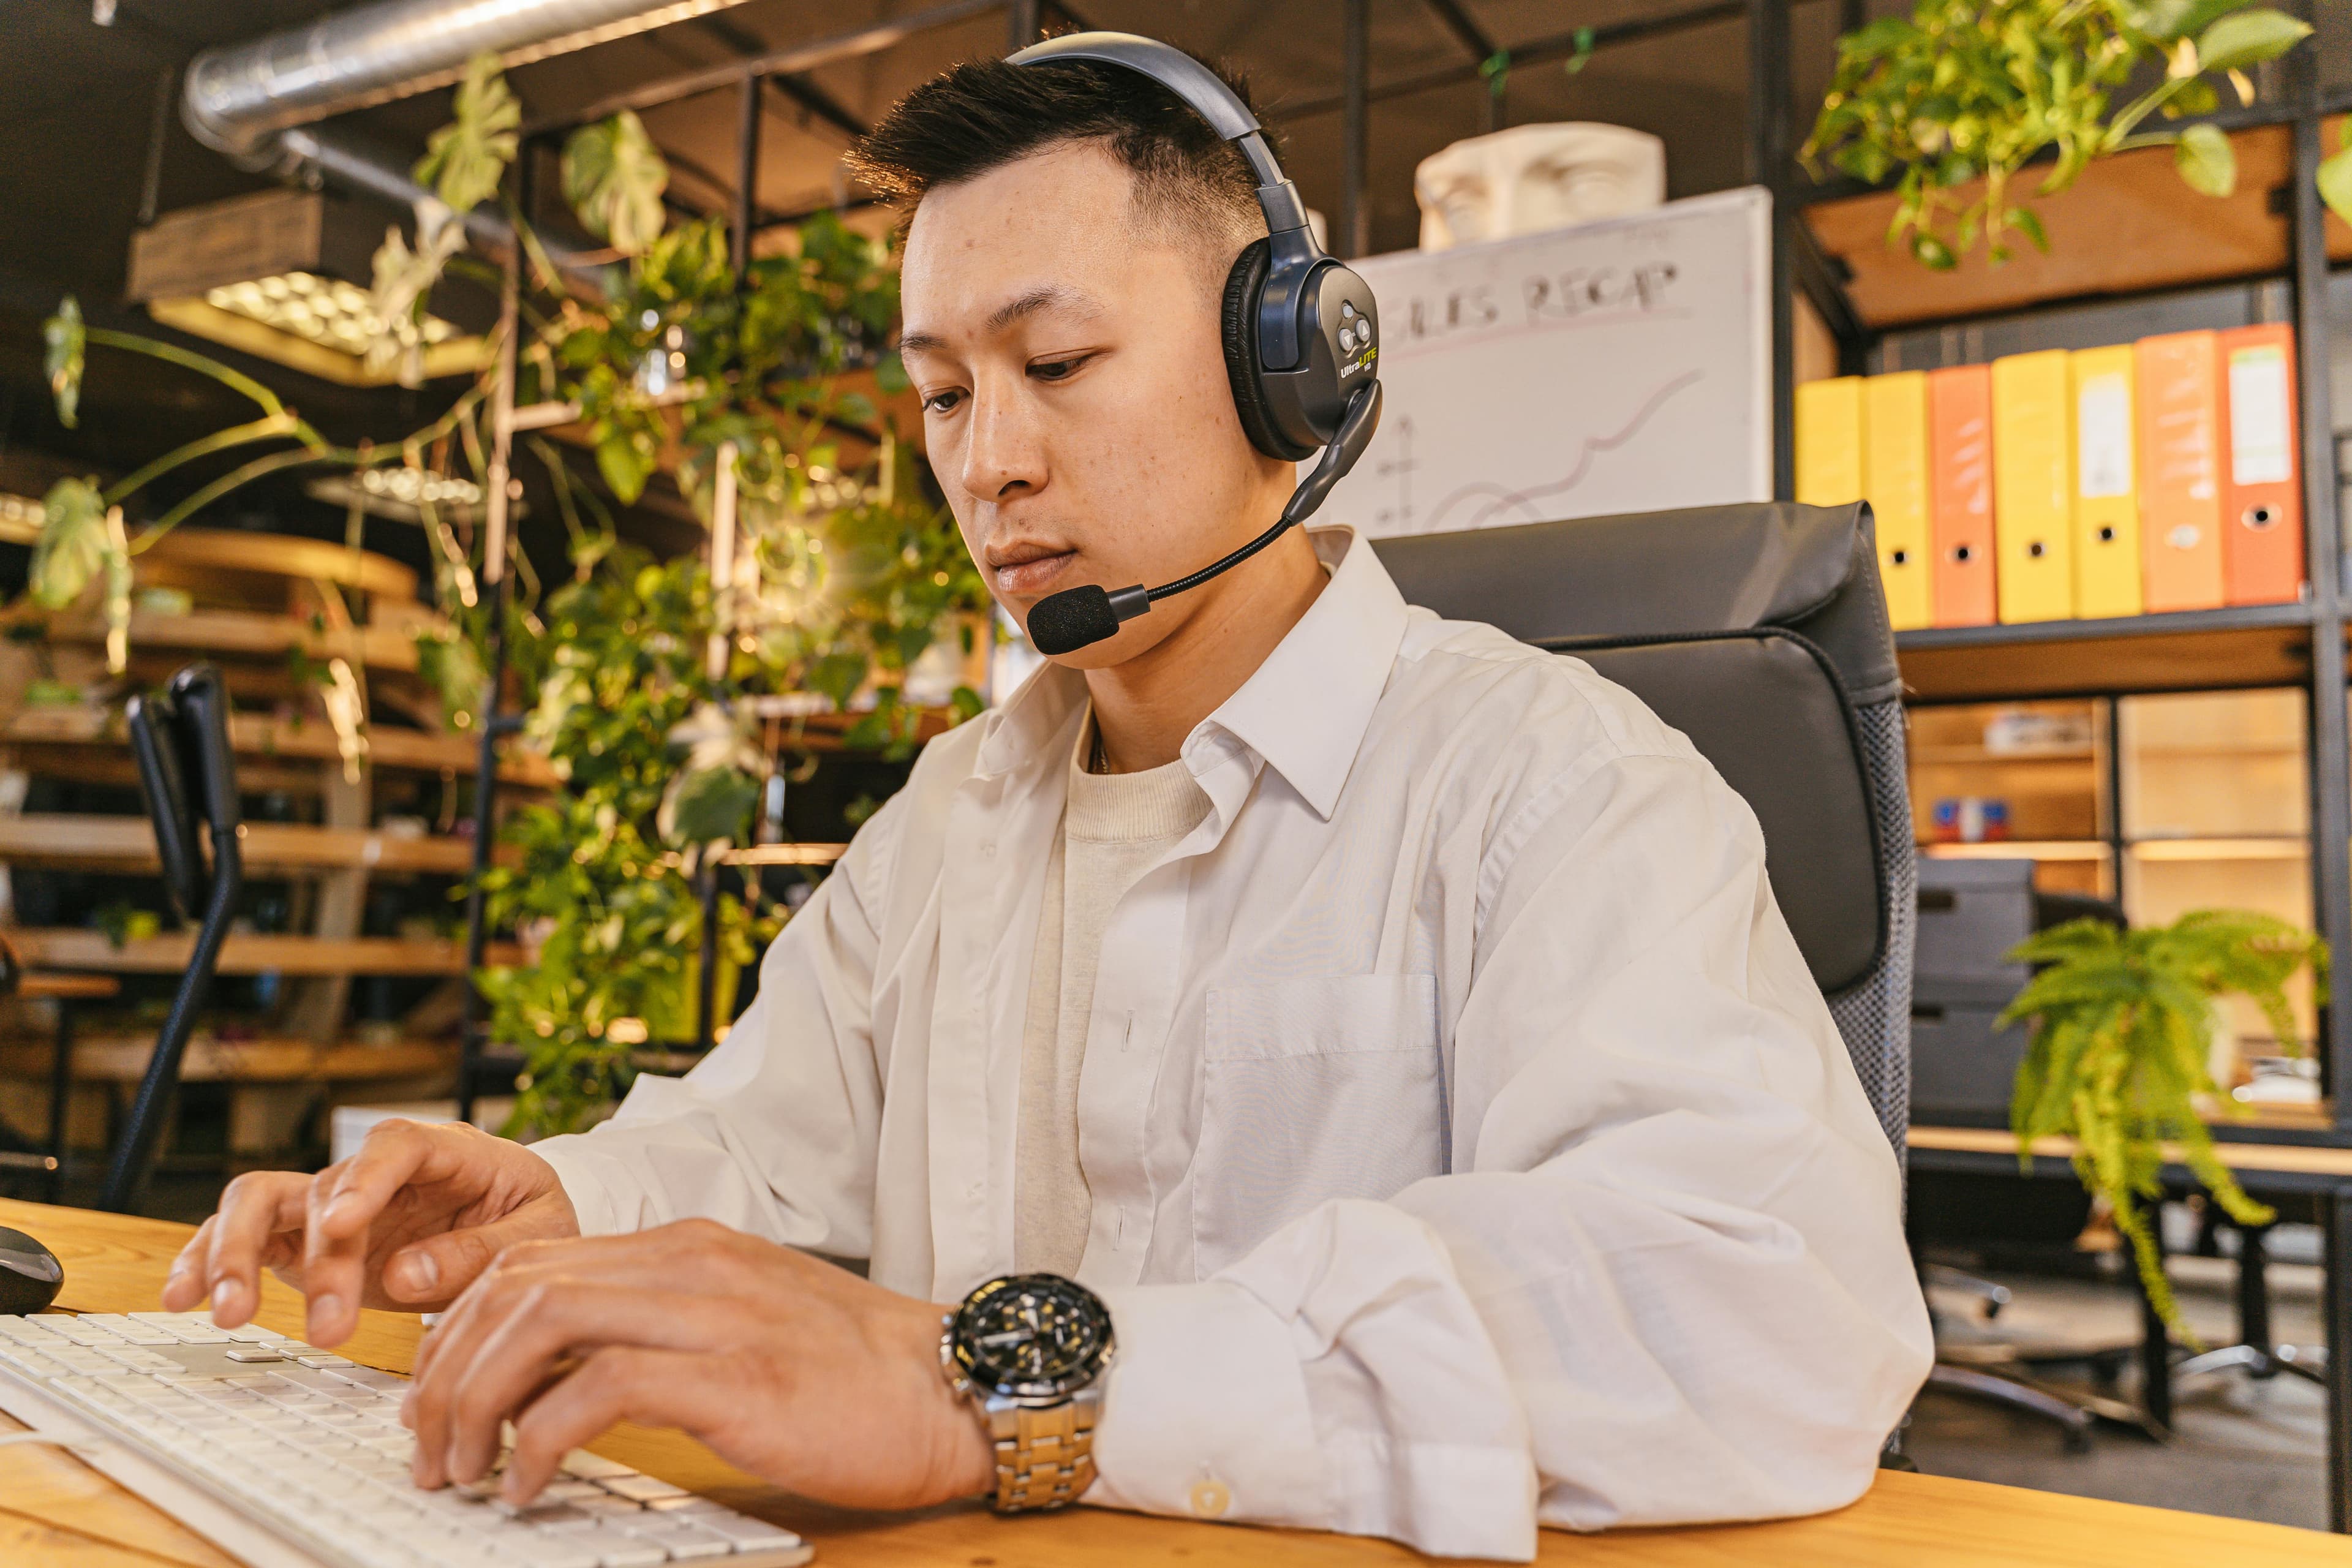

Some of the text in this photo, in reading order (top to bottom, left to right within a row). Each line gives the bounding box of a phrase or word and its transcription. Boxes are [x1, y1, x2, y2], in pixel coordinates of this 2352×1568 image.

[1521, 260, 1678, 327] RECAP
[1341, 347, 1377, 379] UltraLITE
[1364, 362, 1371, 372] HD
